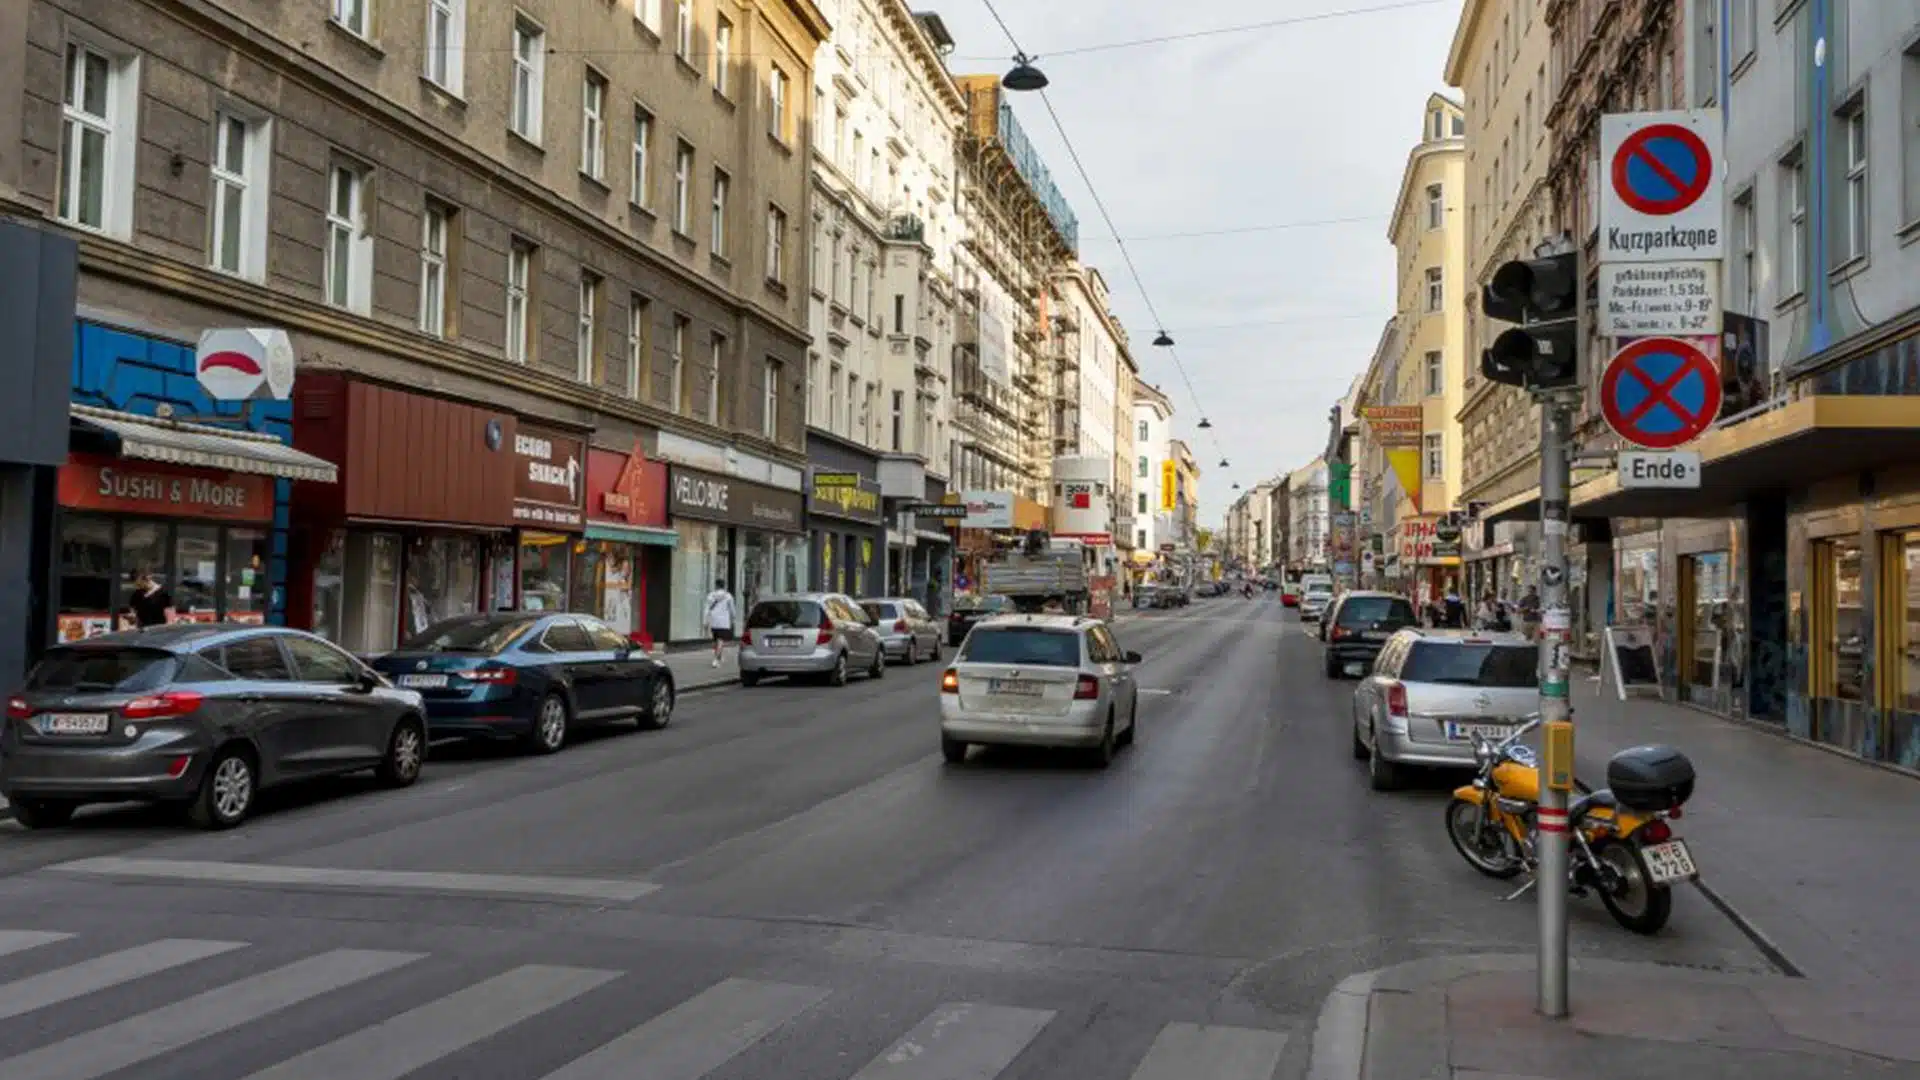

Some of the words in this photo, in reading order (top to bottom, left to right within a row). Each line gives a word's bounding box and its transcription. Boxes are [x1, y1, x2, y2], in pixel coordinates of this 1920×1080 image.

[1608, 225, 1718, 254] Kurzparkzone
[1632, 458, 1686, 478] Ende
[99, 467, 163, 499] SUSHI
[170, 480, 181, 503] &
[190, 478, 244, 507] MORE
[673, 475, 705, 507] VELLO
[707, 481, 728, 512] BIKE
